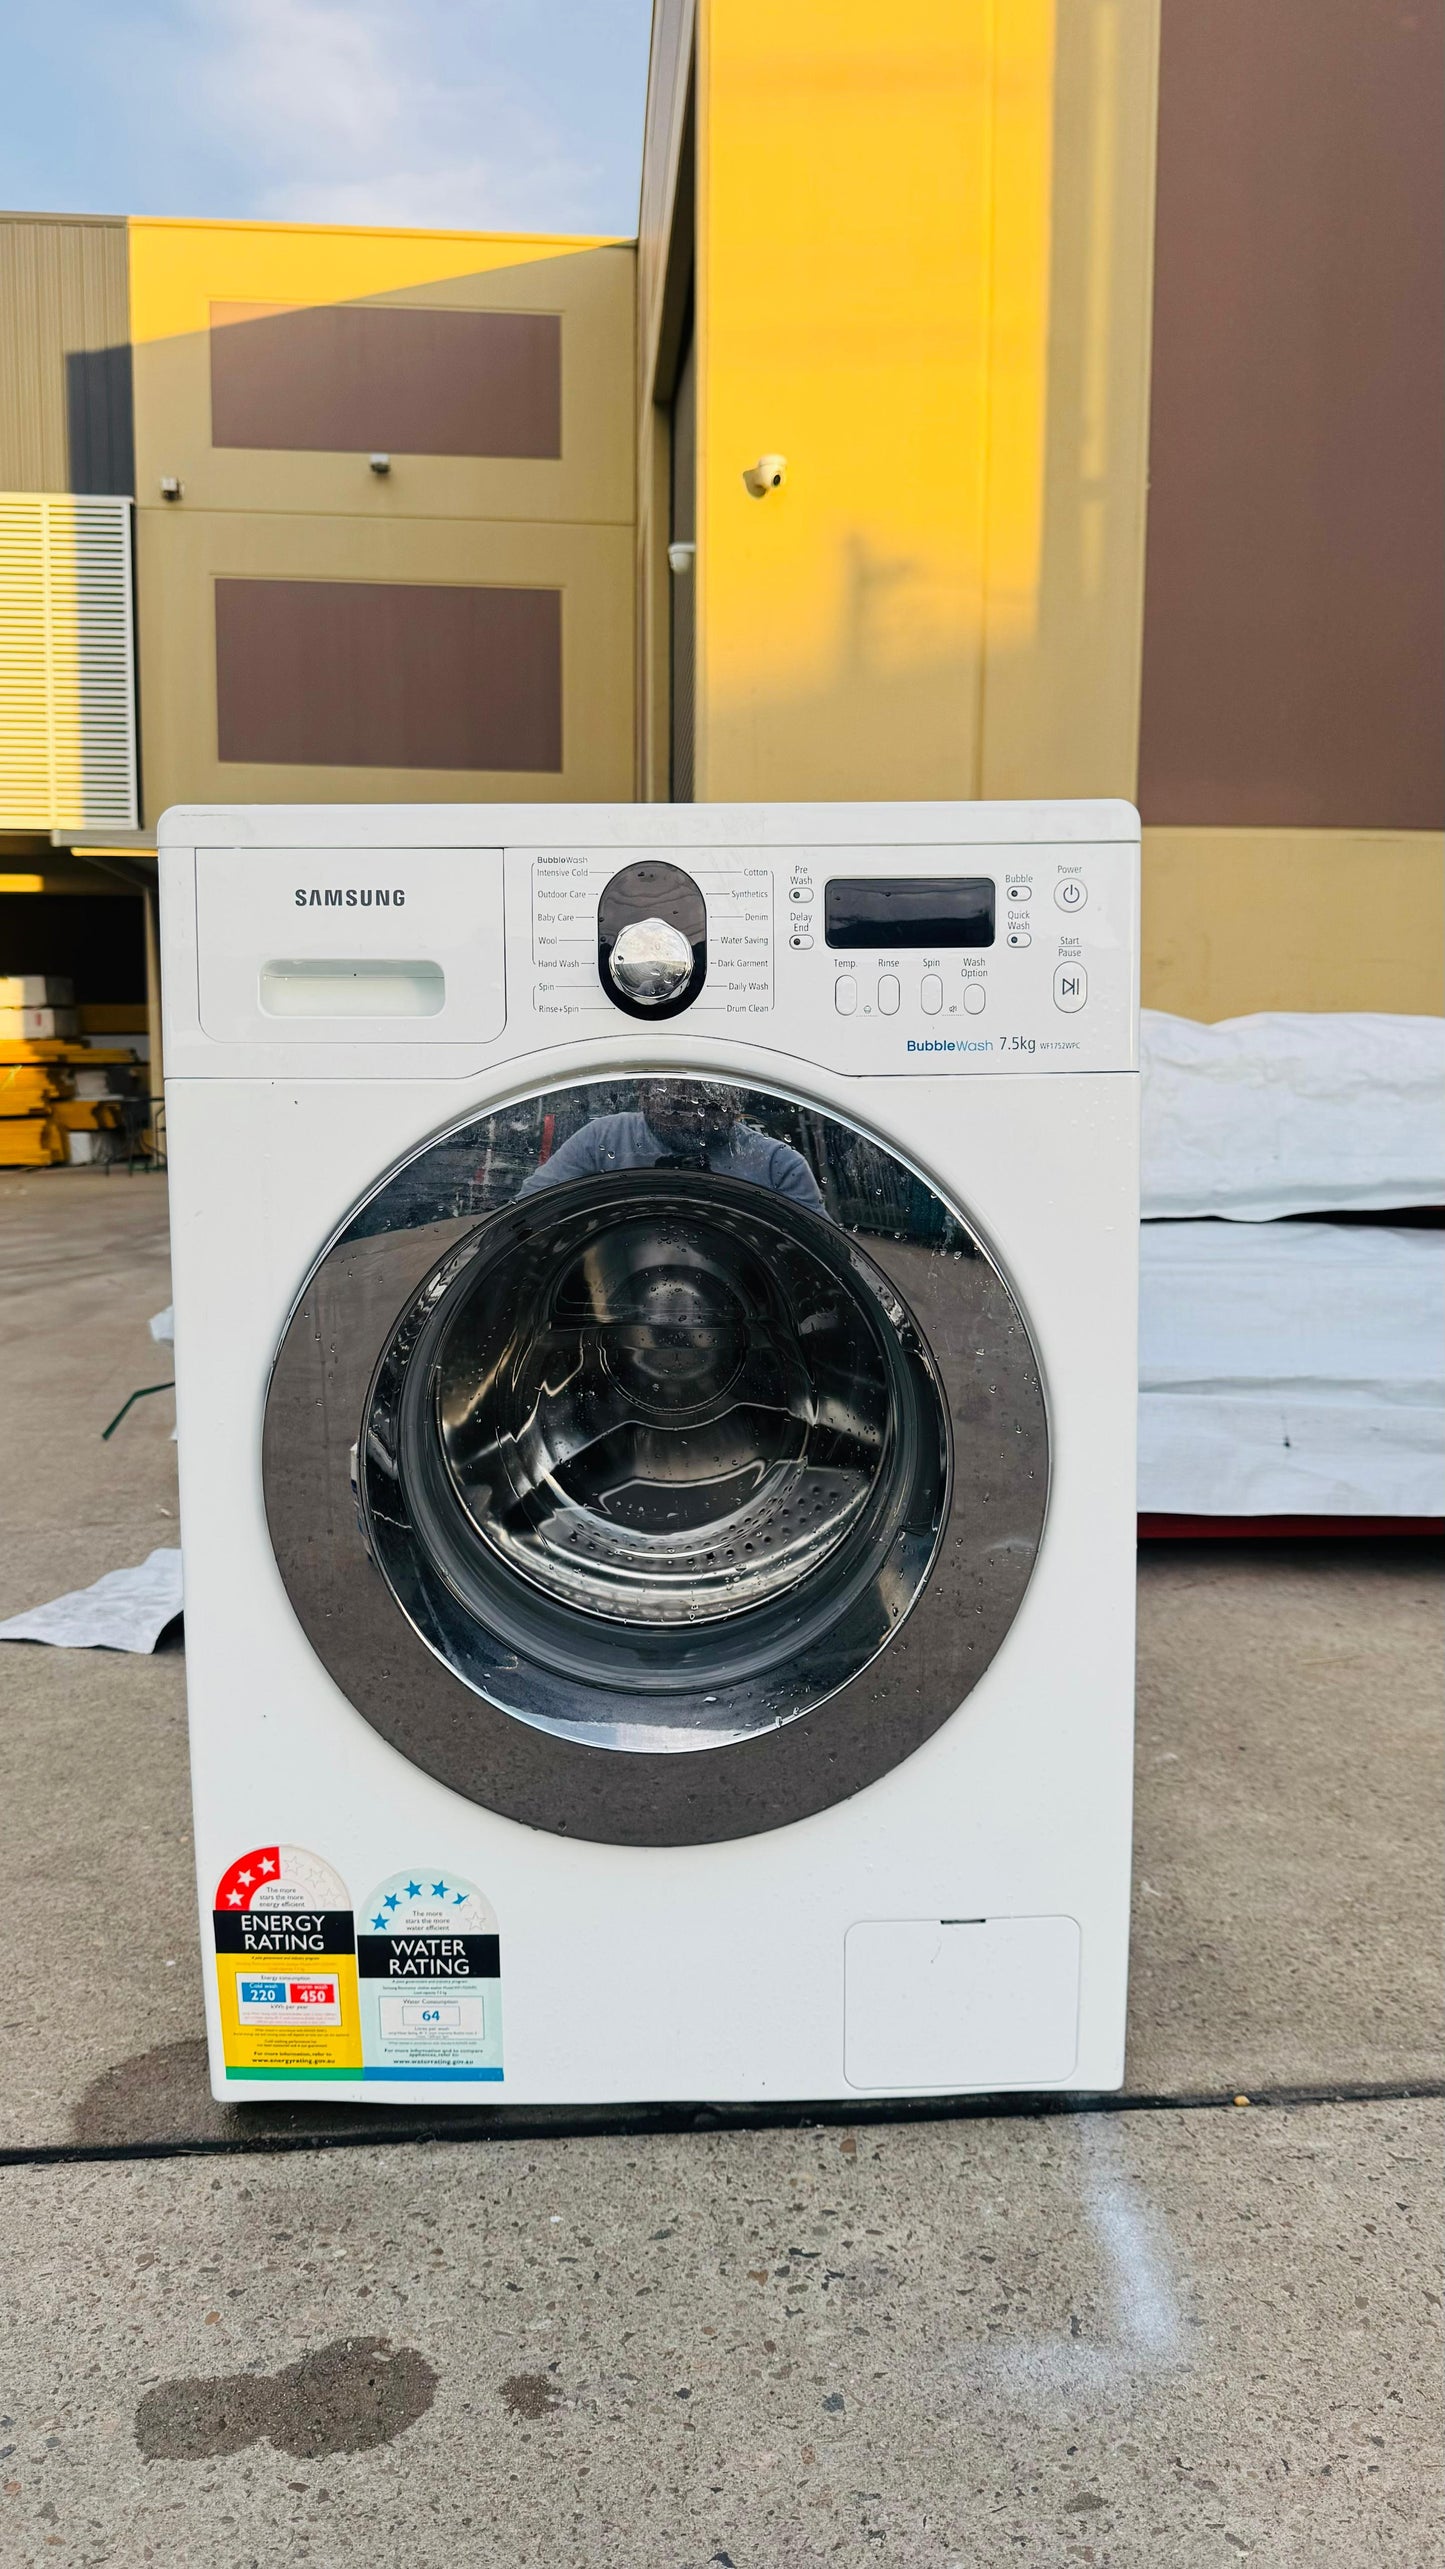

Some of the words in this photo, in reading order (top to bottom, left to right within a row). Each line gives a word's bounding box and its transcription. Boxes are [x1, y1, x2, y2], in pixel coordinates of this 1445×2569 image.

[795, 865, 808, 873] Pre
[1057, 865, 1082, 874] Power
[790, 876, 812, 885] Wash
[1006, 874, 1032, 883] Bubble
[295, 889, 405, 906] SAMSUNG
[538, 891, 567, 899] Outdoor
[732, 890, 768, 898] Synthetics
[538, 914, 555, 922] Baby
[790, 913, 812, 922] Delay
[1008, 910, 1030, 920] Quick
[794, 923, 809, 932] End
[1008, 921, 1030, 930] Wash
[745, 937, 768, 945] Saving
[1061, 937, 1079, 945] Start
[1058, 948, 1081, 957] Pause
[834, 959, 857, 968] Temp.
[878, 959, 899, 967] Rinse
[923, 958, 940, 968] Spin
[963, 958, 985, 966] Wash
[961, 969, 988, 978] Option
[539, 983, 554, 991] Spin
[729, 983, 746, 991] Daily
[539, 1005, 579, 1014] Rinse+Spin
[907, 1040, 993, 1051] BubbleWash
[1000, 1036, 1035, 1053] 7.5kg
[241, 1915, 325, 1931] ENERGY
[244, 1934, 324, 1951] RATING
[391, 1940, 465, 1956] WATER
[390, 1959, 469, 1975] RATING
[250, 1990, 275, 2001] 220
[300, 1990, 325, 2002] 450
[422, 2010, 440, 2021] 64
